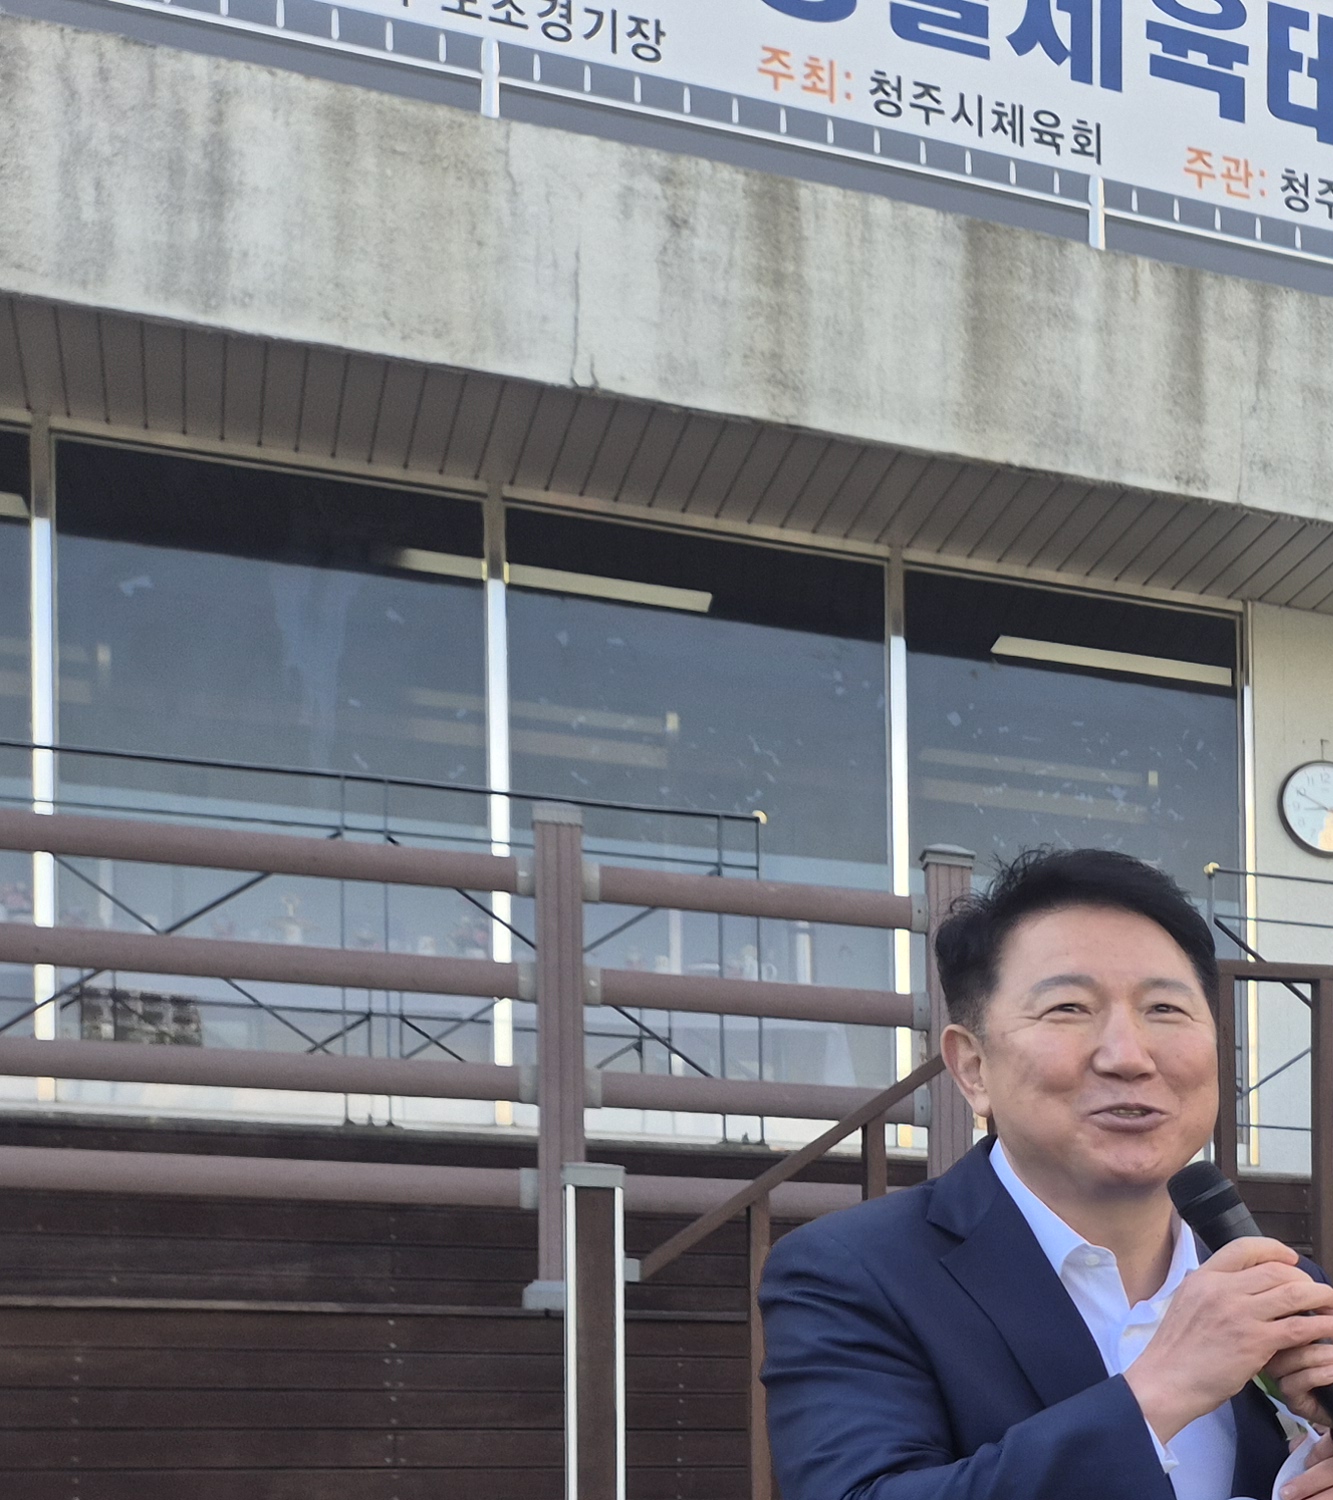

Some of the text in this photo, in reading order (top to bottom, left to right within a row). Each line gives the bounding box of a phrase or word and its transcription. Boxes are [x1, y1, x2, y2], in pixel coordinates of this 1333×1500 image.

[759, 46, 855, 103] 주최:
[868, 70, 1102, 166] 청주시체육회
[1184, 147, 1267, 199] 주관:
